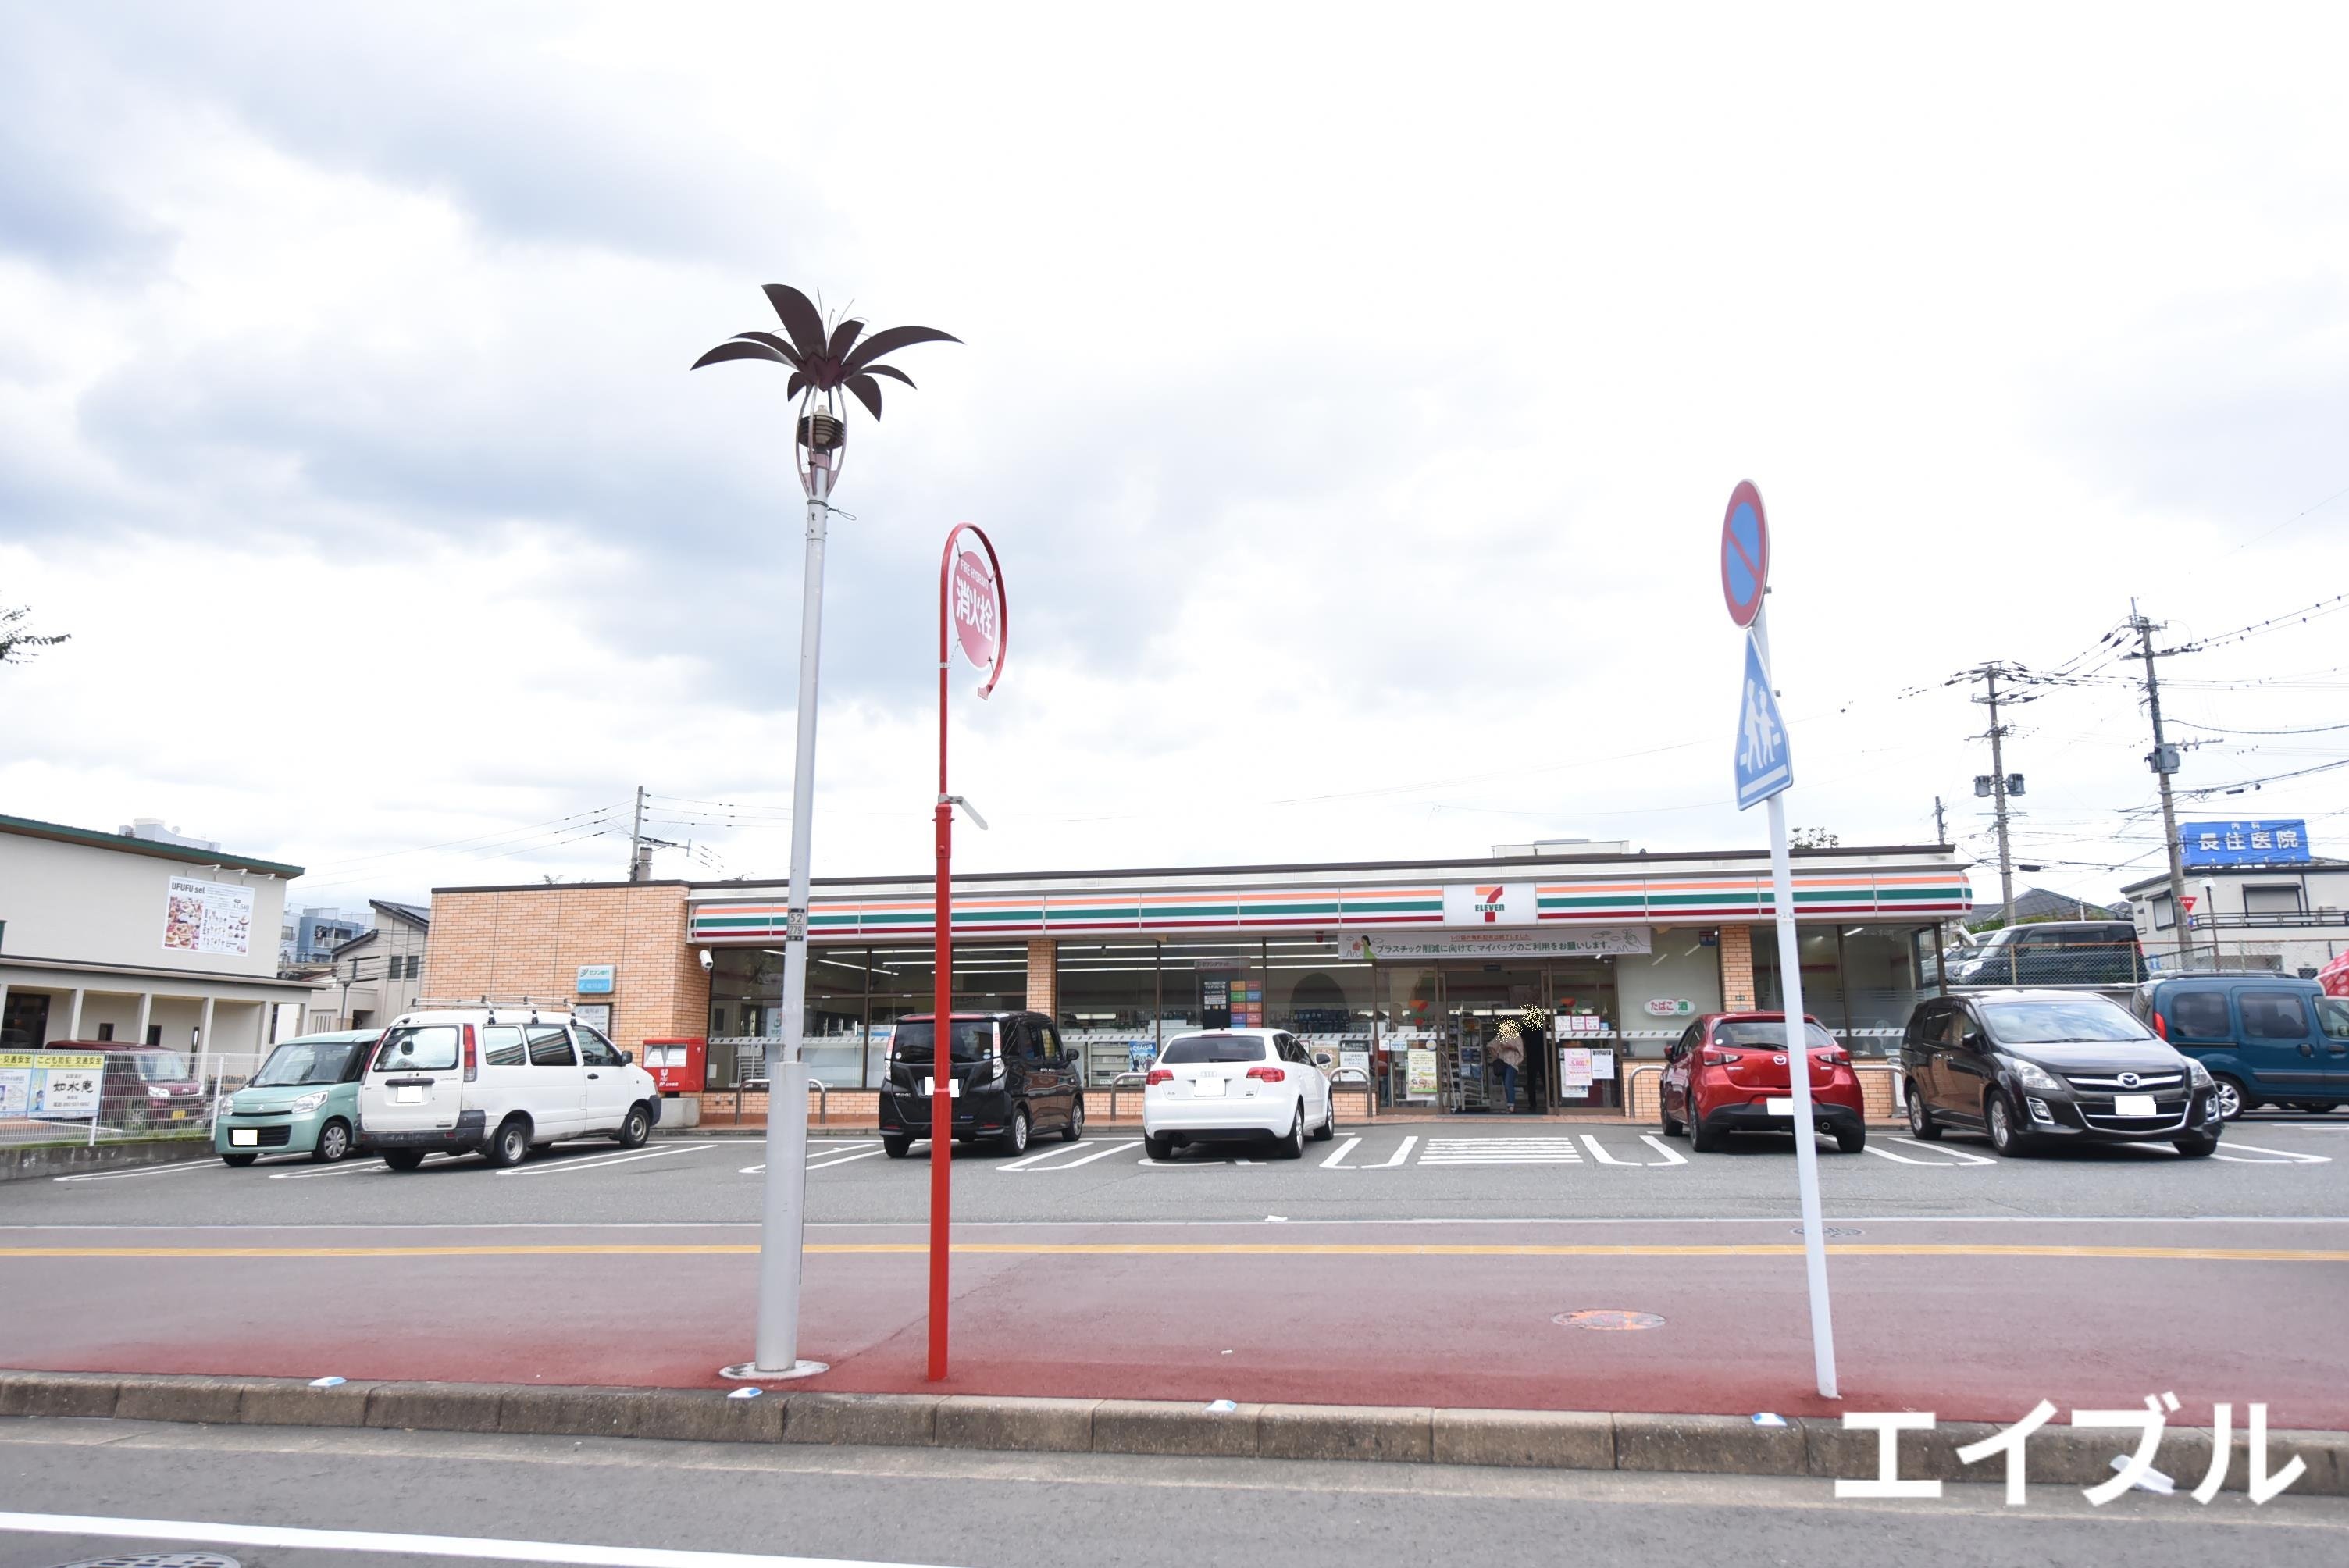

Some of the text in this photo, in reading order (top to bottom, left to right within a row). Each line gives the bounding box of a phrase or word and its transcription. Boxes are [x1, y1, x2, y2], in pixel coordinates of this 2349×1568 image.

[961, 559, 989, 590] FIRE HYDRANT
[956, 575, 993, 641] 消火栓
[2198, 830, 2299, 851] 長住医院
[171, 882, 194, 893] UFUFU
[790, 914, 803, 922] 52
[790, 925, 802, 934] 279
[1376, 941, 1611, 953] プラスチック削減に向けて、マイバッグのご利用をお願いします。
[1650, 1001, 1688, 1010] たばこ 酒
